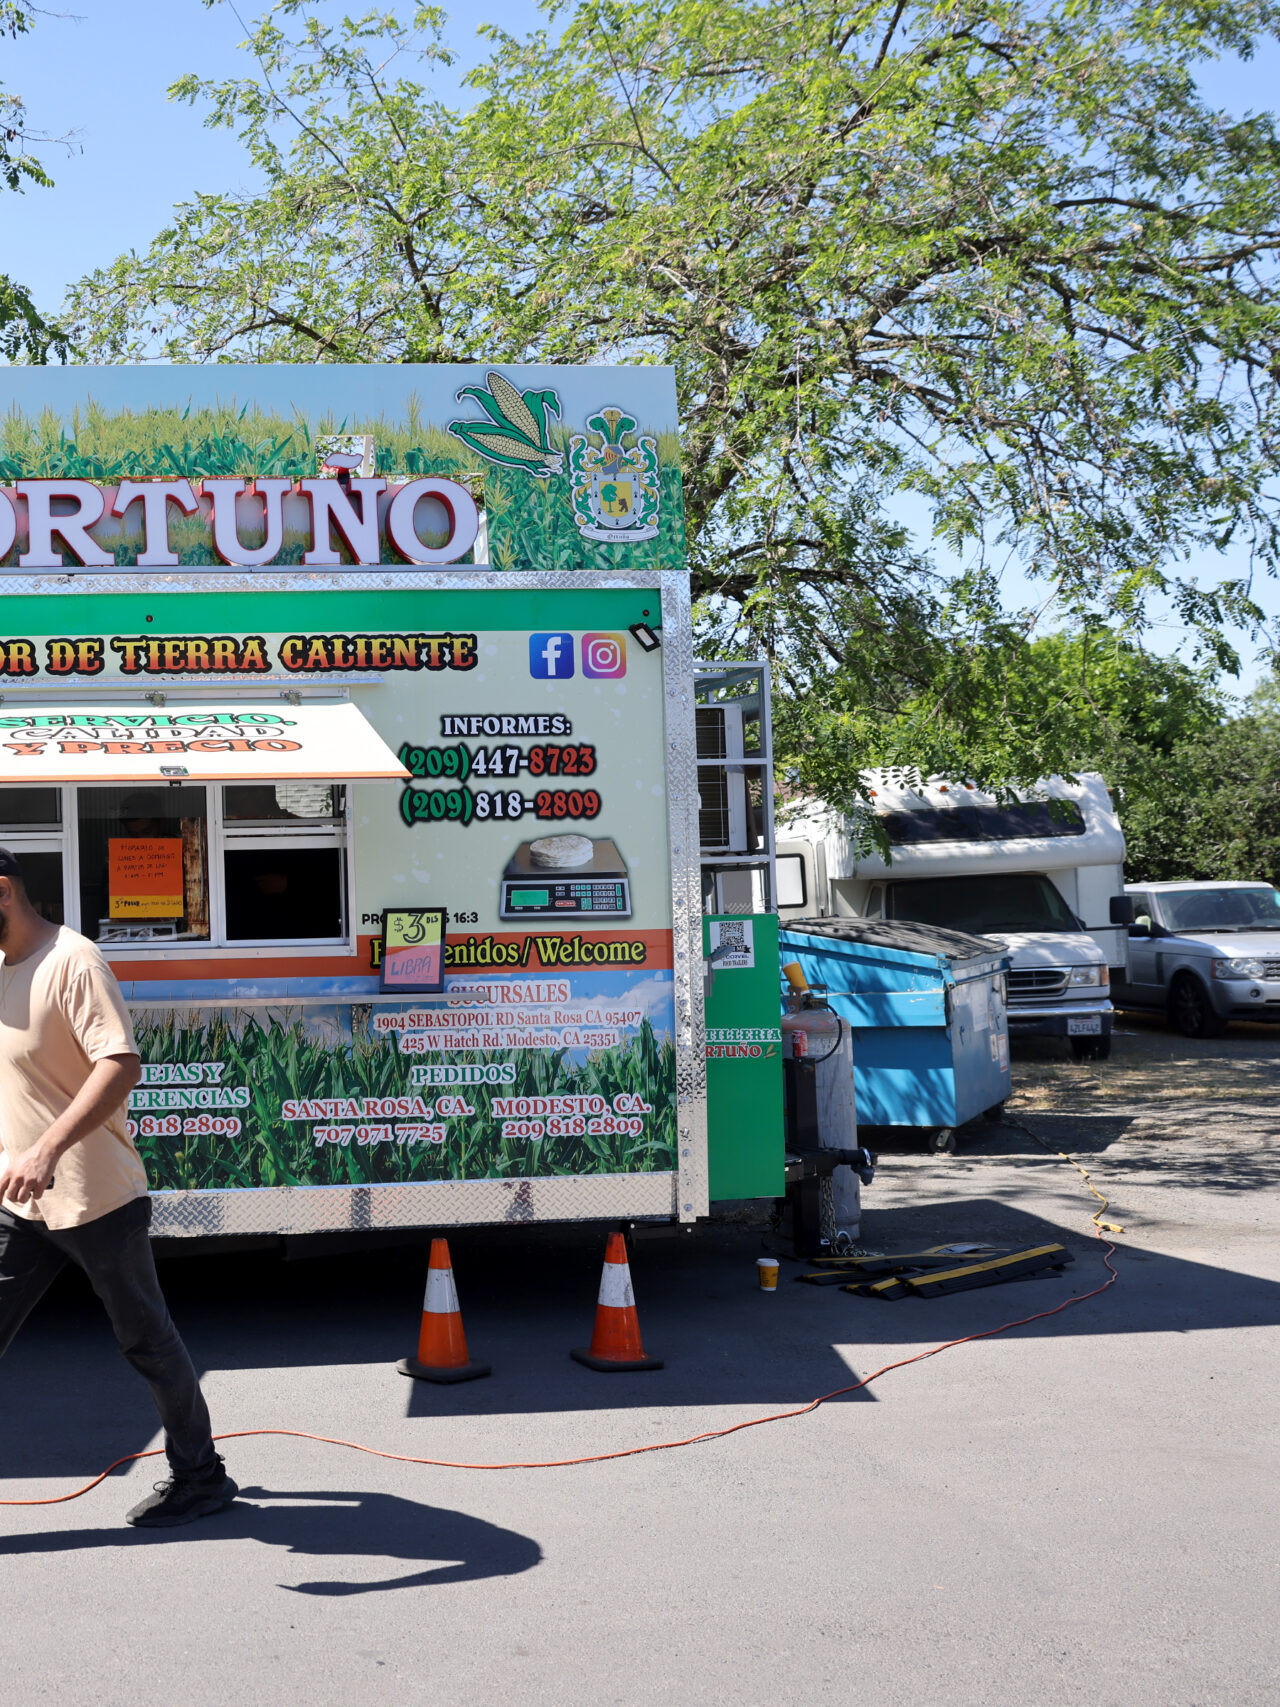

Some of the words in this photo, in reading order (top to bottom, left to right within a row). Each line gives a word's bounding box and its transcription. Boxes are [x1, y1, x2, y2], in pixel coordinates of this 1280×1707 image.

[47, 640, 103, 673] DE
[112, 637, 270, 671] TIERRA
[280, 635, 475, 669] CALIENTE
[10, 725, 285, 741] CALIDAD
[443, 715, 572, 735] INFORMES:
[2, 741, 47, 756] Y
[58, 739, 303, 755] PRECIO
[426, 915, 439, 924] DLS
[453, 911, 479, 923] 16:3
[376, 1016, 406, 1031] 1904
[408, 1012, 494, 1028] SEBASTOPOL
[496, 1012, 515, 1026] RD
[517, 1011, 551, 1025] Santa
[554, 1010, 583, 1024] Rosa
[585, 1009, 602, 1023] CA
[605, 1010, 641, 1026] 95407
[402, 1037, 424, 1051] 425
[427, 1035, 441, 1049] W
[444, 1034, 480, 1048] Hatch
[482, 1033, 503, 1047] Rd.
[506, 1032, 561, 1049] Modesto,
[563, 1032, 581, 1046] CA
[583, 1032, 617, 1047] 25351
[705, 1028, 782, 1041] TILLERIA
[705, 1042, 762, 1057] RTUÑO
[145, 1065, 200, 1081] EJAS
[204, 1064, 222, 1081] Y
[415, 1066, 515, 1084] PEDIDOS
[128, 1088, 248, 1108] ERENCIAS
[492, 1096, 610, 1118] MODESTO,
[615, 1095, 652, 1113] CA.
[283, 1098, 363, 1119] SANTA
[364, 1098, 431, 1120] ROSA,
[436, 1097, 474, 1115] CA.
[141, 1116, 179, 1134] 818
[184, 1116, 238, 1136] 2809
[315, 1126, 356, 1146] 707
[358, 1124, 392, 1144] 971
[395, 1124, 444, 1144] 7725
[505, 1119, 543, 1137] 209
[549, 1116, 585, 1134] 818
[591, 1115, 643, 1135] 2809
